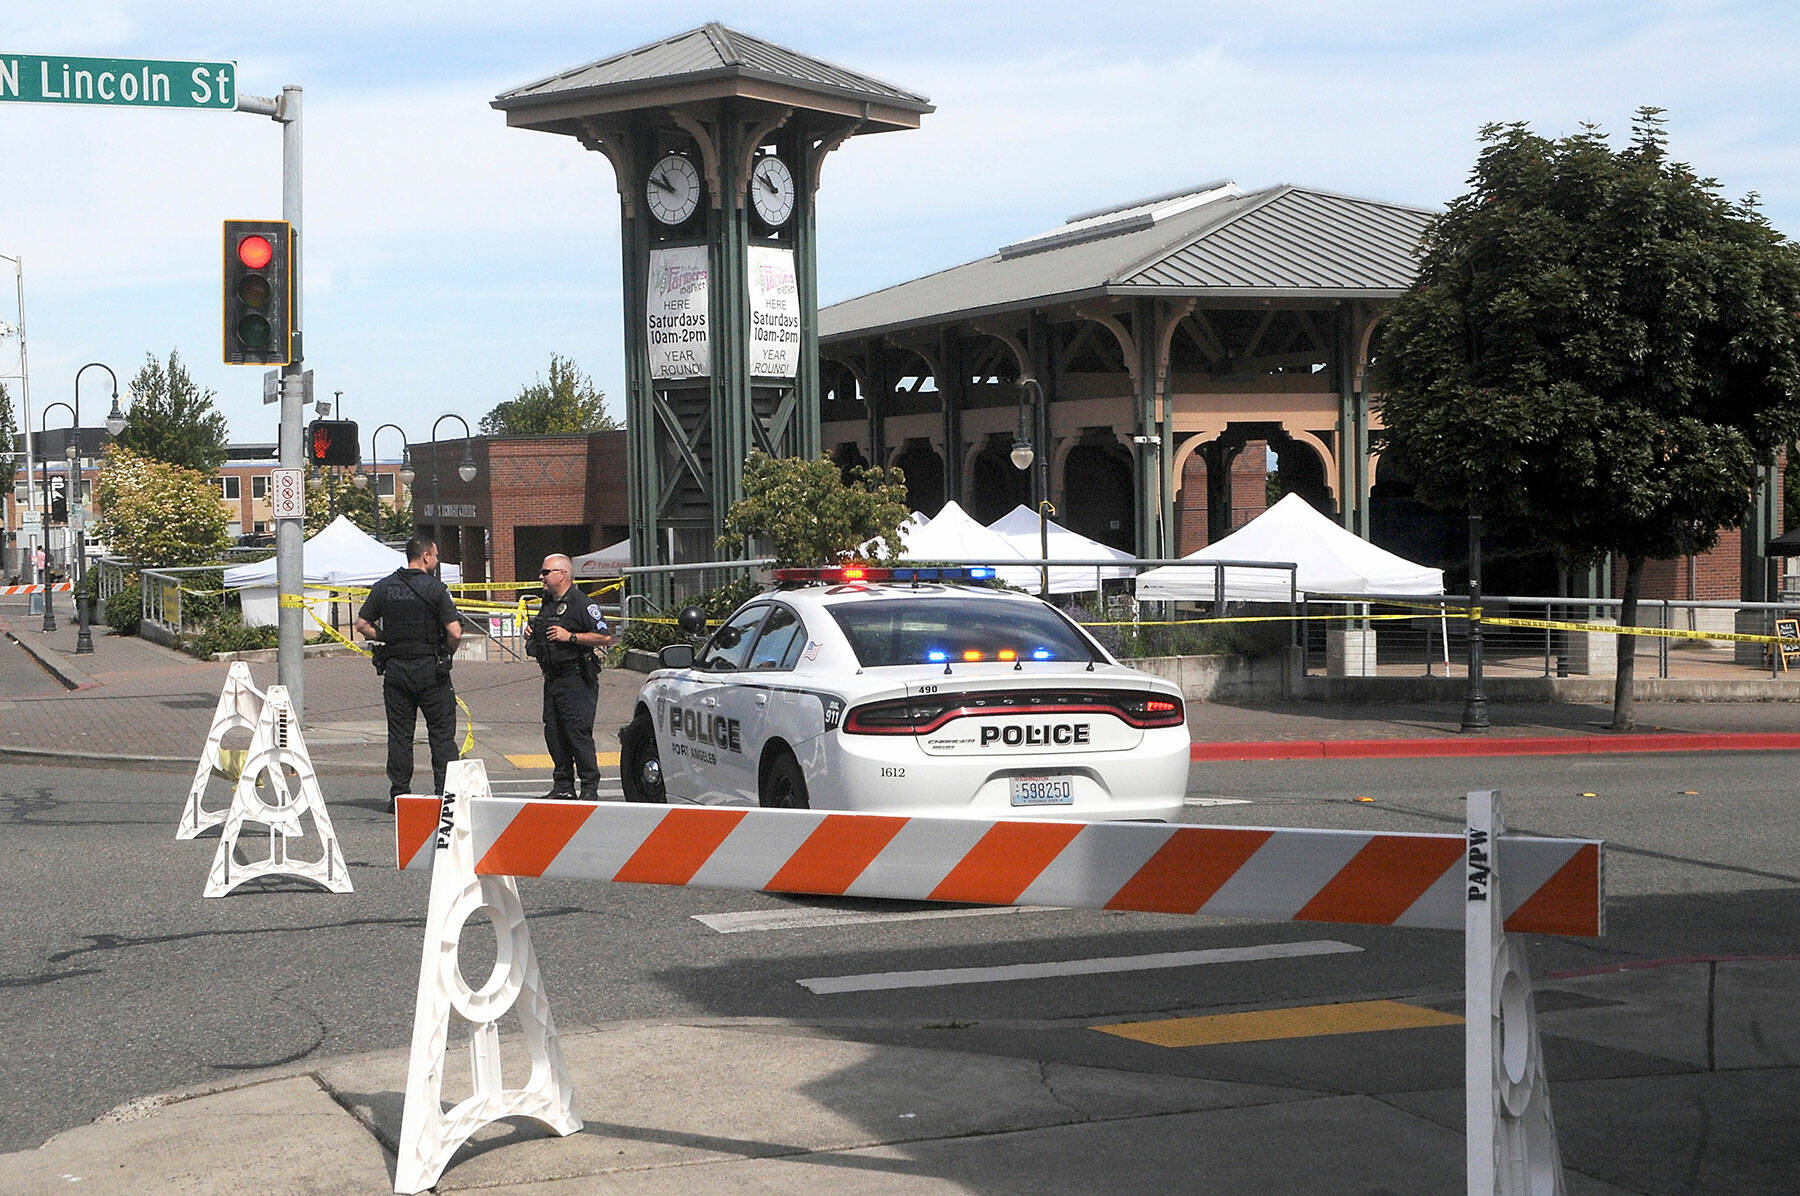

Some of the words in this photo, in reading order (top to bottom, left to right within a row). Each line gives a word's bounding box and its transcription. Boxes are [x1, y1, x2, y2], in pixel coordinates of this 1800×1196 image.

[0, 60, 19, 96] N
[41, 61, 170, 101] Lincoln
[191, 67, 230, 104] St
[663, 299, 690, 311] HERE
[765, 299, 787, 311] HERE
[648, 313, 706, 330] Saturdays
[753, 310, 799, 328] Saturdays
[651, 328, 707, 345] 10am-2pm
[754, 327, 798, 343] 10am-2pm
[664, 349, 695, 362] YEAR
[762, 348, 787, 361] YEAR
[918, 685, 938, 694] 490
[825, 709, 840, 725] 911
[670, 706, 743, 754] POLICE
[980, 723, 1091, 748] POLICE
[880, 767, 906, 778] 1612
[1021, 781, 1071, 799] 598250
